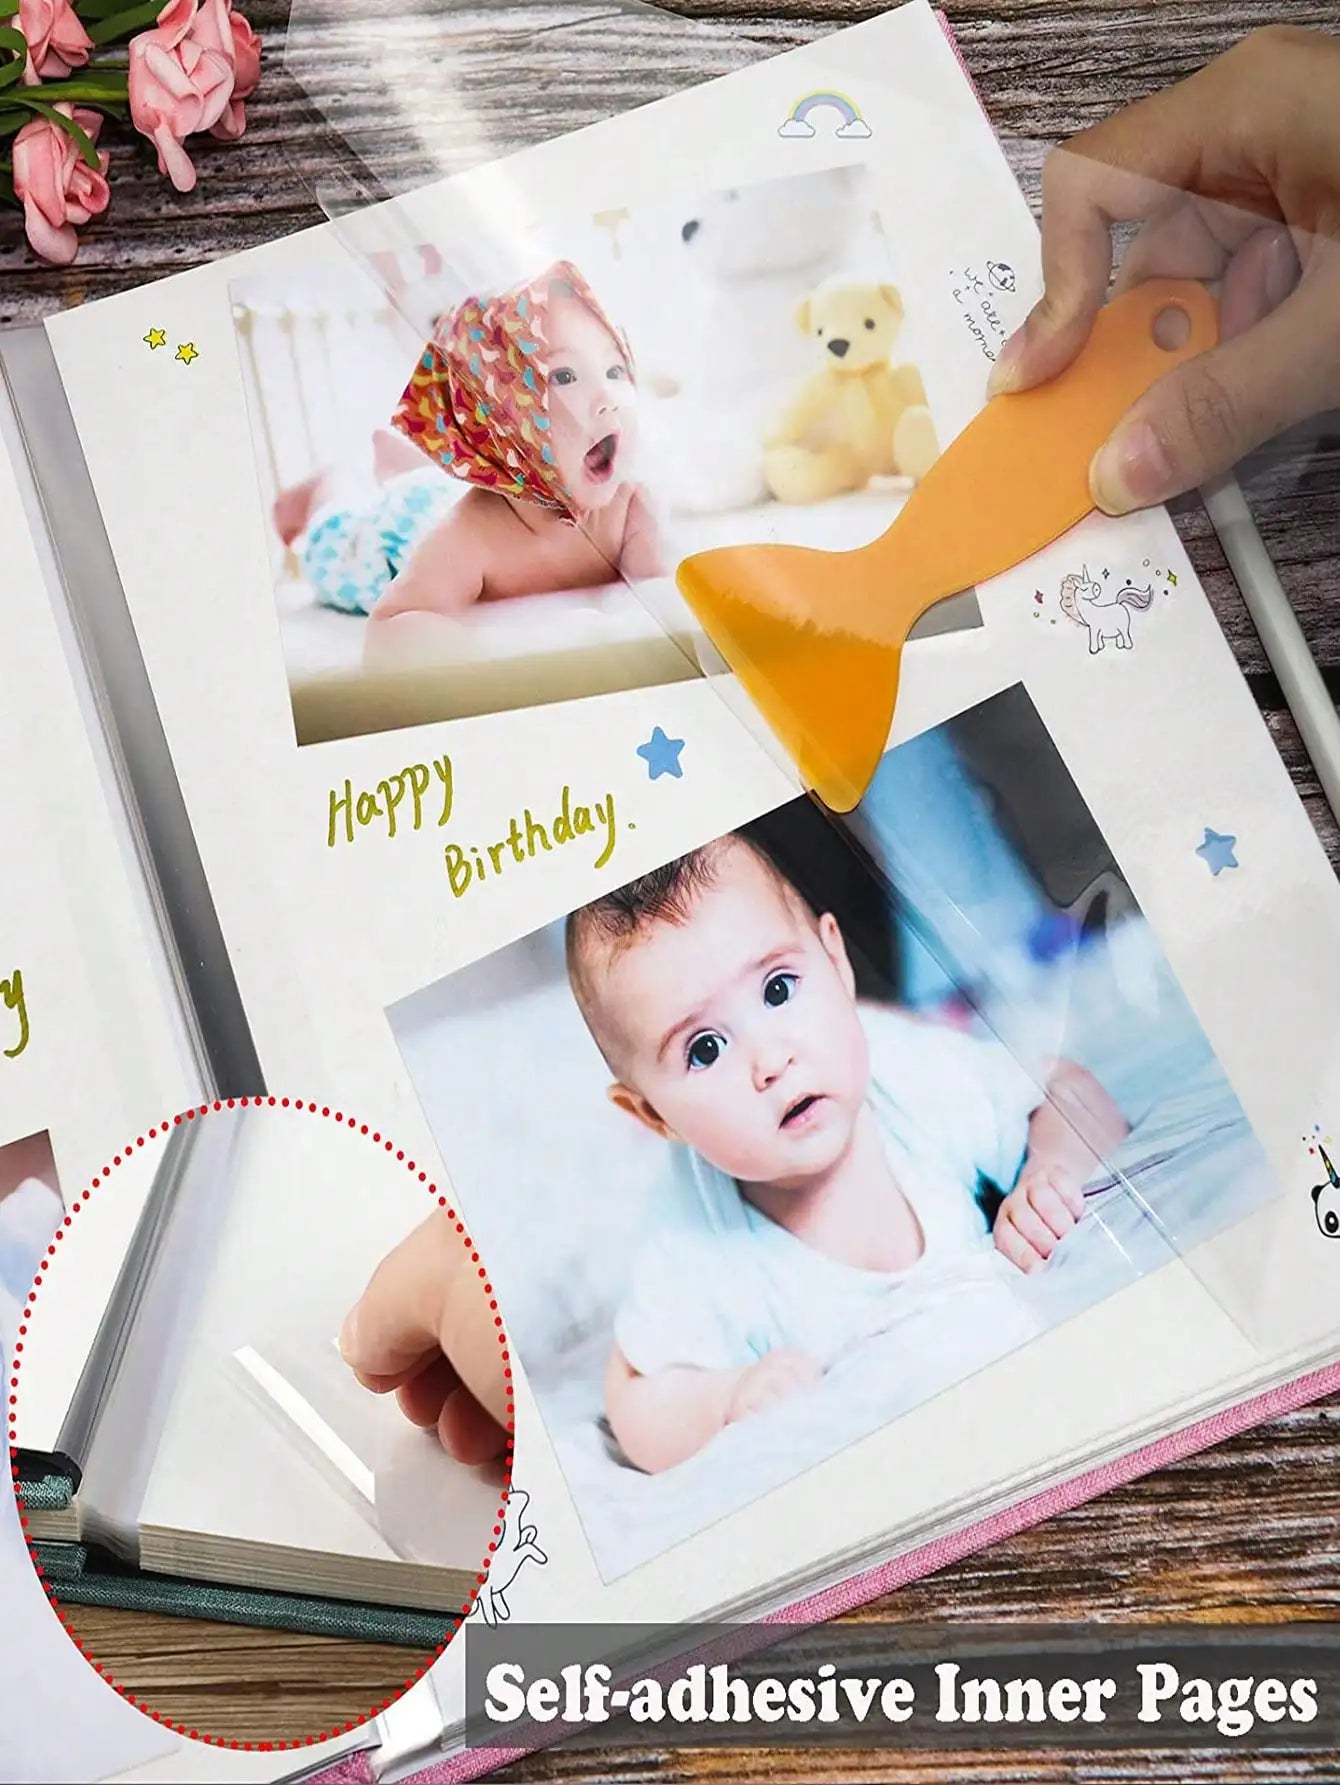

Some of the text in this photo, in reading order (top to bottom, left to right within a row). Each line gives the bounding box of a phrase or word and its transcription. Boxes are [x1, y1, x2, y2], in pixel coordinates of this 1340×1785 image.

[963, 313, 996, 362] mome
[327, 755, 453, 847] Happy
[445, 786, 636, 898] Birthday.
